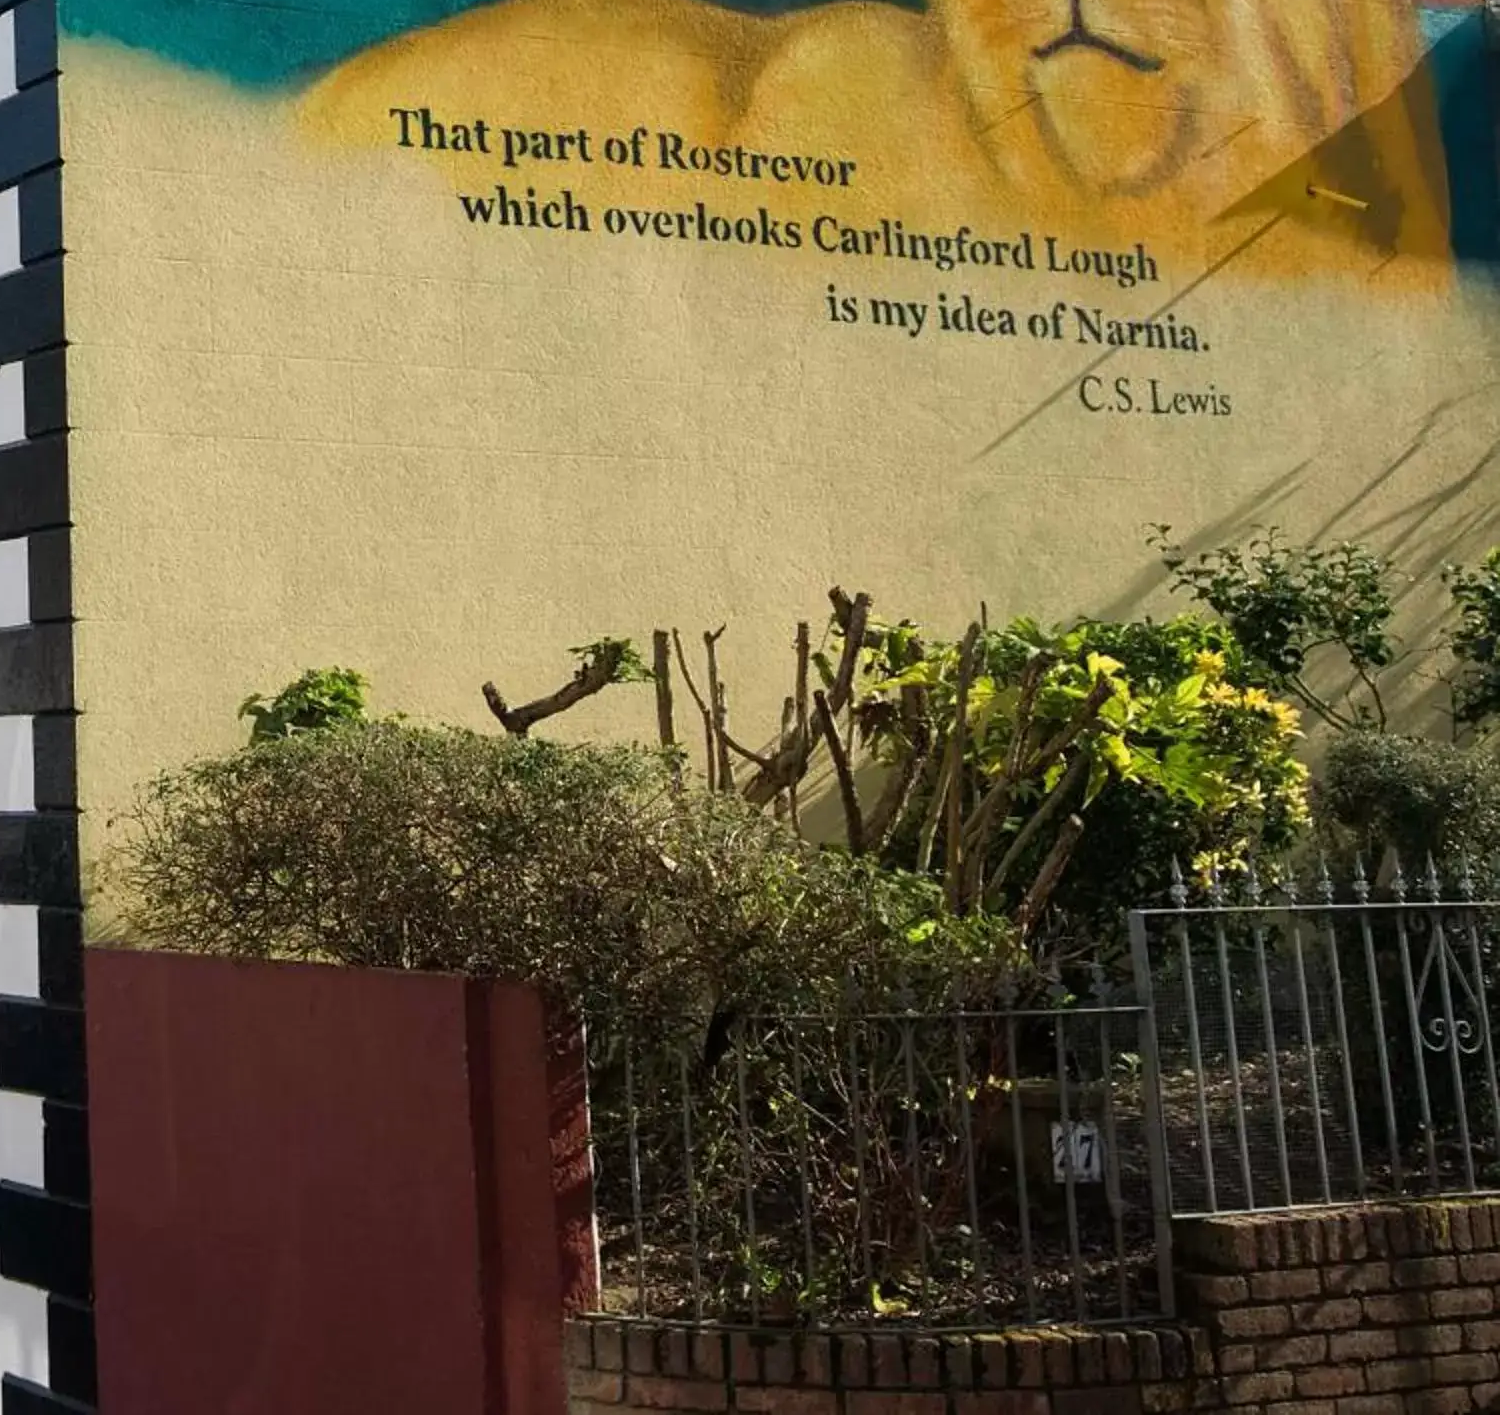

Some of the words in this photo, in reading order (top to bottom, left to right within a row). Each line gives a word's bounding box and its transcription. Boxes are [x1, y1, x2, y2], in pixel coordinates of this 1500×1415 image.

[389, 107, 490, 154] That
[501, 127, 593, 169] part
[604, 127, 648, 167] of
[658, 132, 857, 187] Rostrevor
[459, 187, 590, 232] which
[604, 202, 802, 248] overlooks
[812, 215, 1035, 271] Carlingford
[1047, 237, 1159, 288] Lough
[825, 285, 857, 323] is
[869, 296, 928, 337] my
[937, 294, 1016, 337] idea
[1028, 303, 1067, 339] of
[1073, 306, 1210, 351] Narnia.
[1079, 376, 1142, 414] C.S.
[1150, 379, 1232, 416] Lewis
